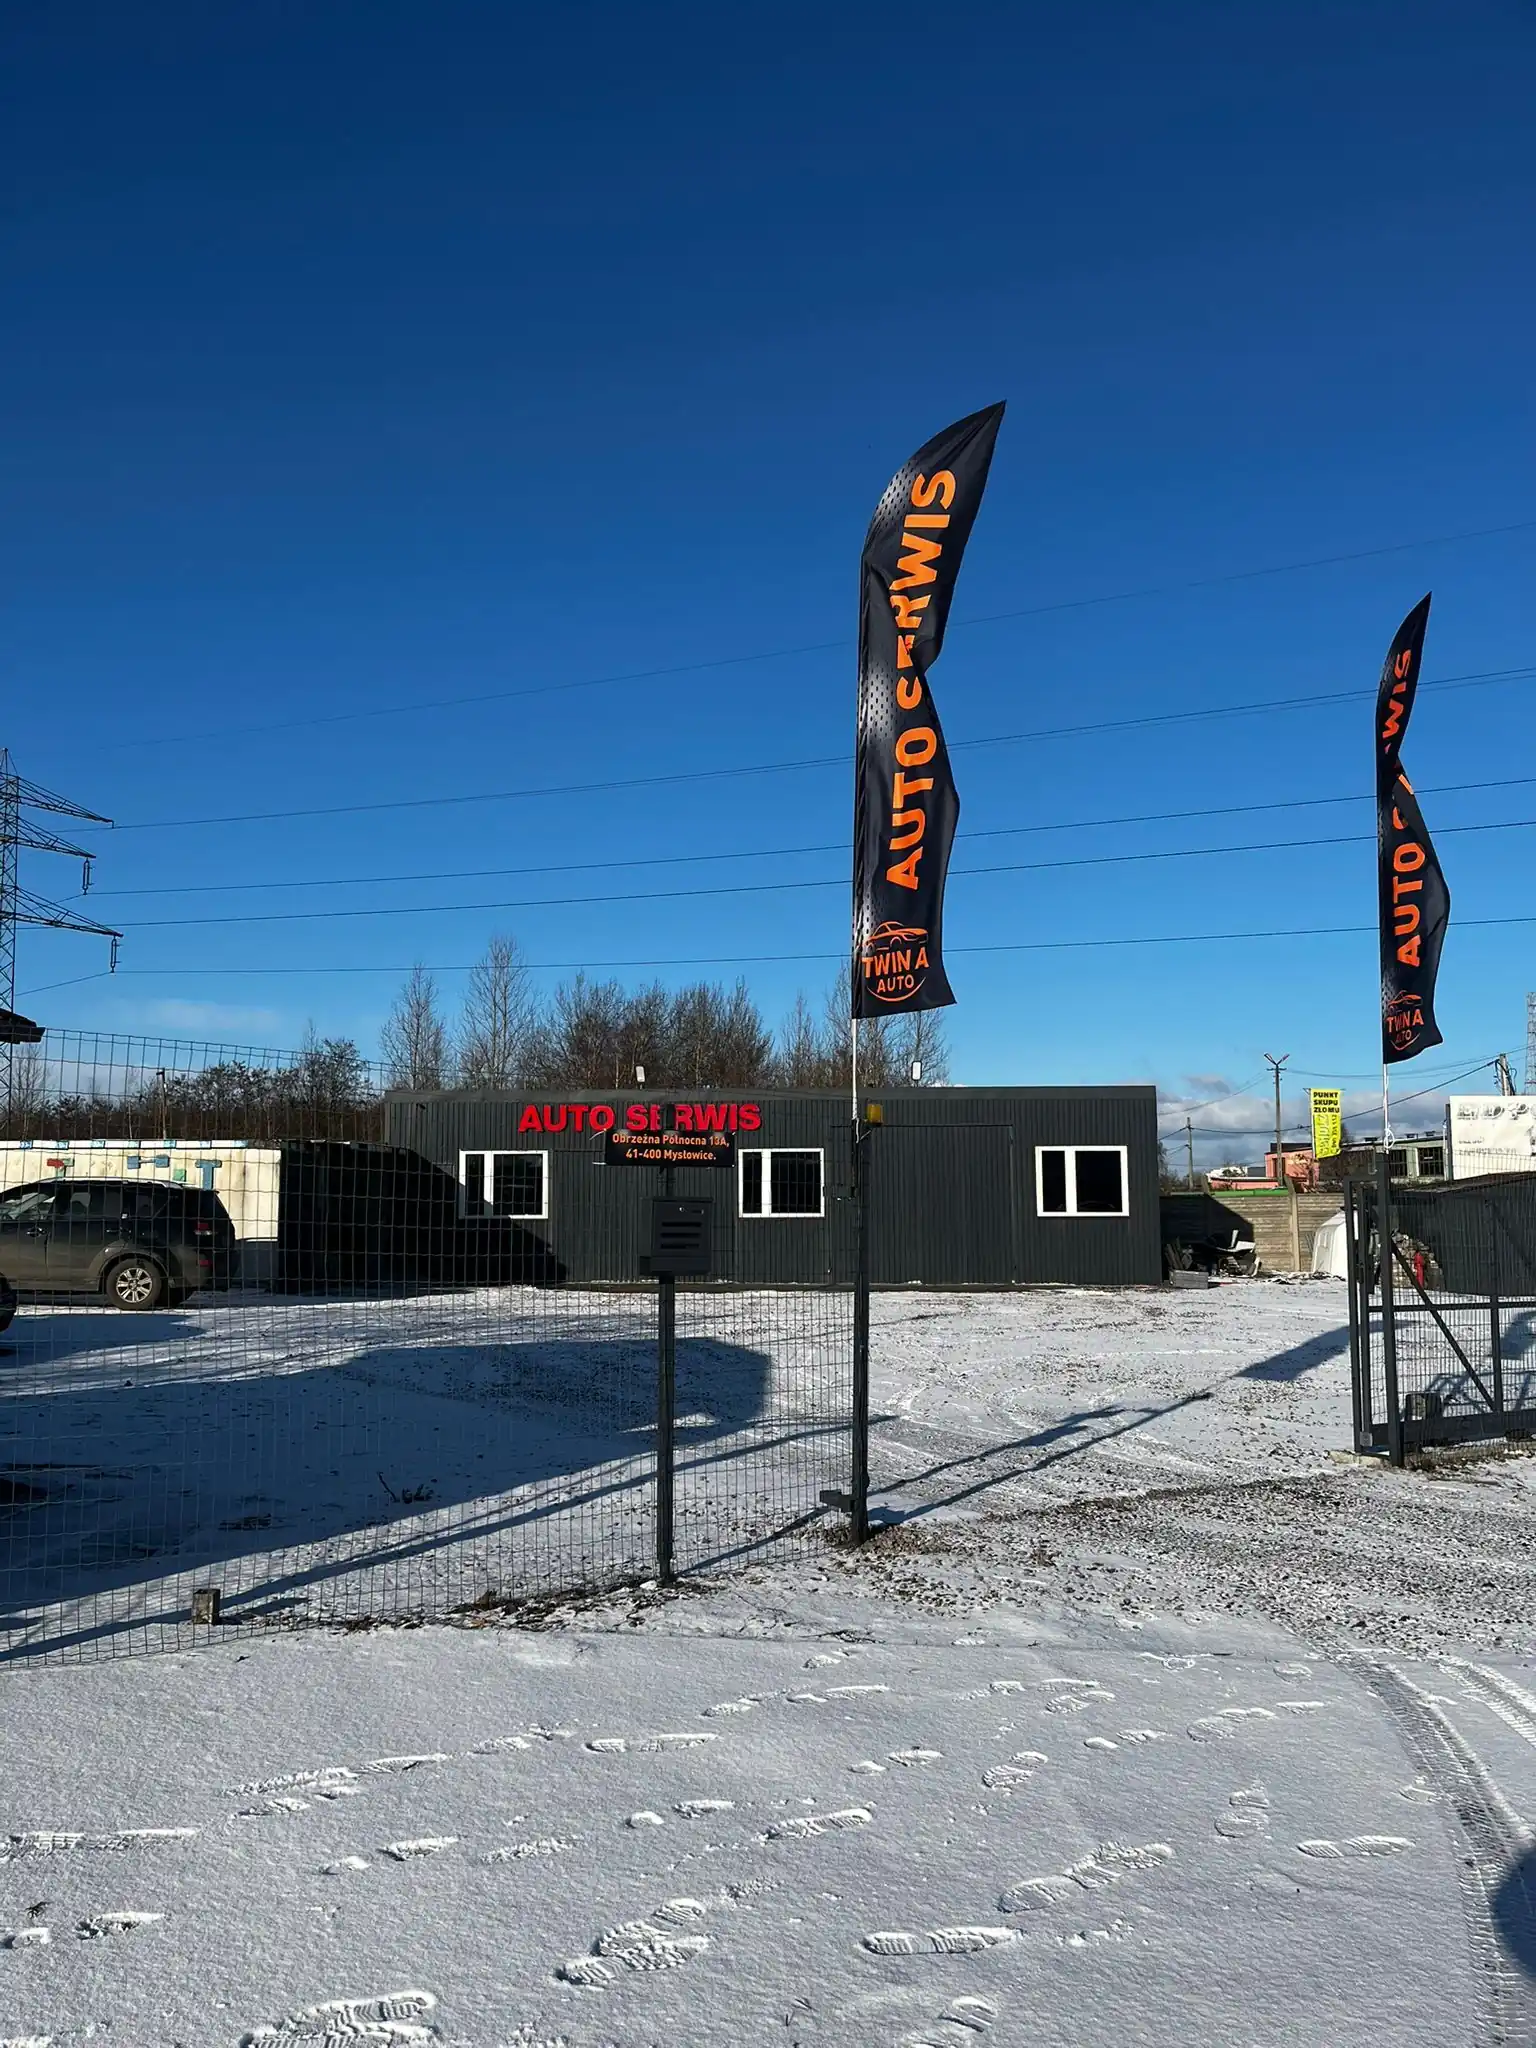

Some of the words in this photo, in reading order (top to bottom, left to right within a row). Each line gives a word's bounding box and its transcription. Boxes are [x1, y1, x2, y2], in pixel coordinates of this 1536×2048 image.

[887, 726, 938, 890] AUTO
[1392, 842, 1426, 967] AUTO
[862, 949, 911, 978] TWIN
[914, 946, 930, 970] A
[876, 974, 914, 993] AUTO
[1412, 1008, 1425, 1026] A
[1395, 1029, 1412, 1044] ATO
[518, 1104, 615, 1132] AUTO
[612, 1133, 660, 1144] Obrzeżna
[662, 1132, 707, 1145] Północna
[709, 1135, 730, 1147] 13A,
[625, 1148, 661, 1159] 41-400
[663, 1149, 717, 1161] Mysłowice.
